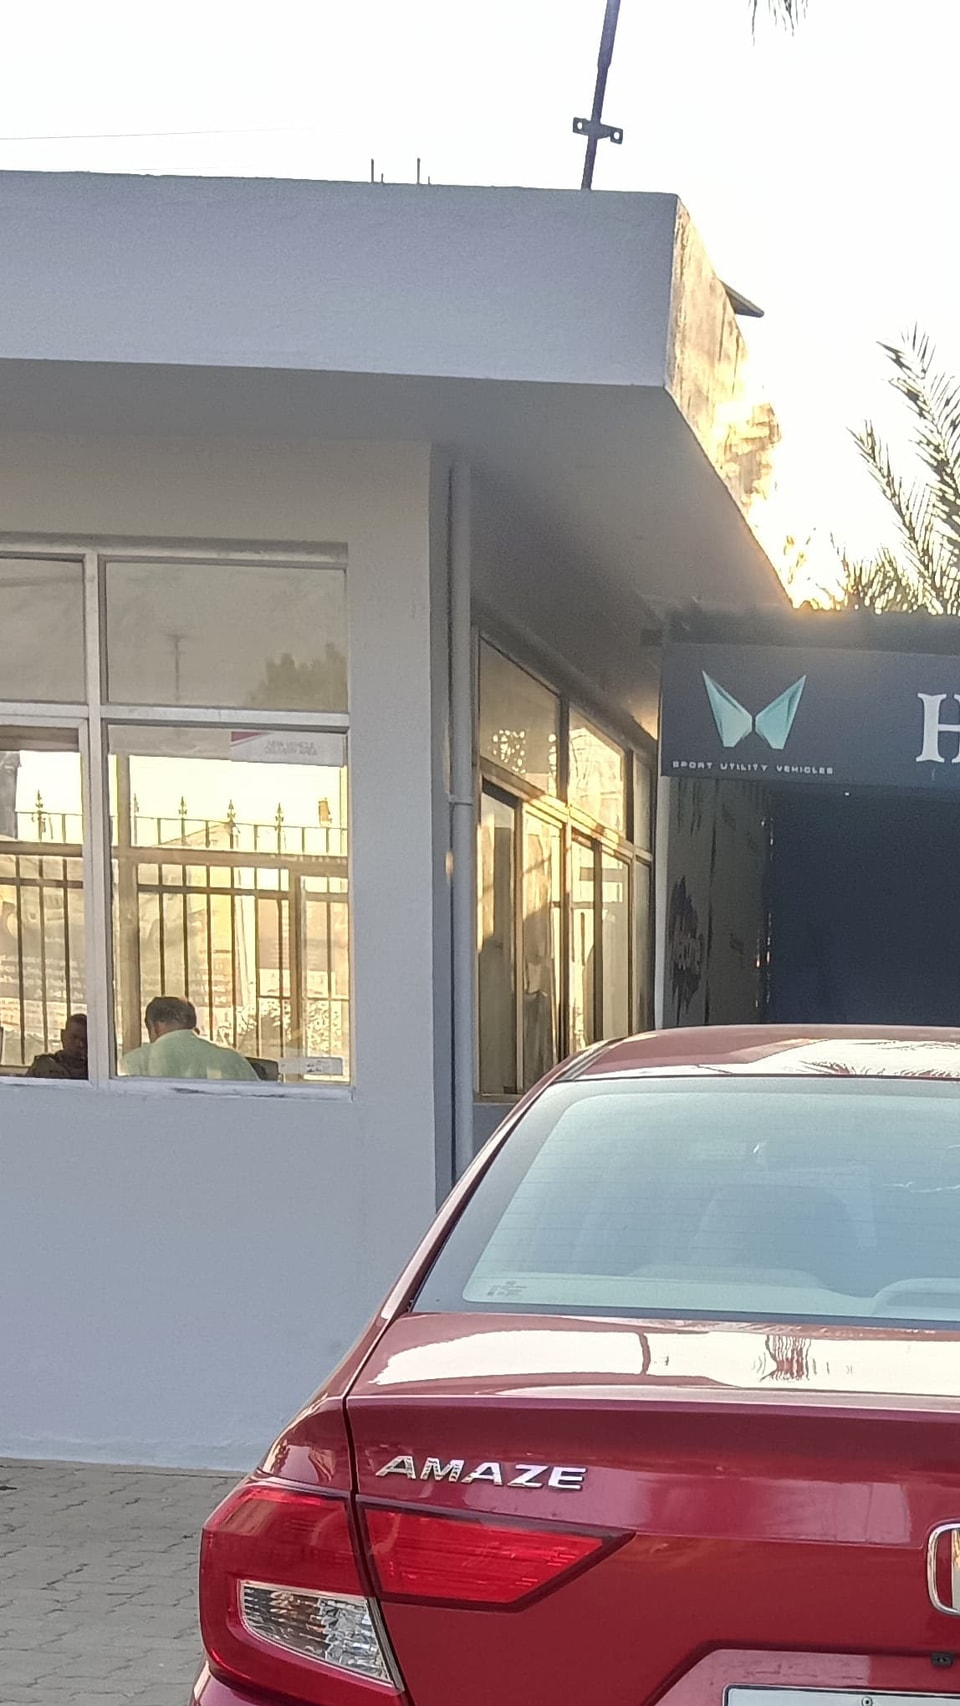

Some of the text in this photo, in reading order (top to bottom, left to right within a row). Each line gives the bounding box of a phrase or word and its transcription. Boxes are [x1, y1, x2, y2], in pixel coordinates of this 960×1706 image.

[672, 760, 834, 775] SPORT UTILITY VEHICLES
[375, 1455, 588, 1491] AMAZE
